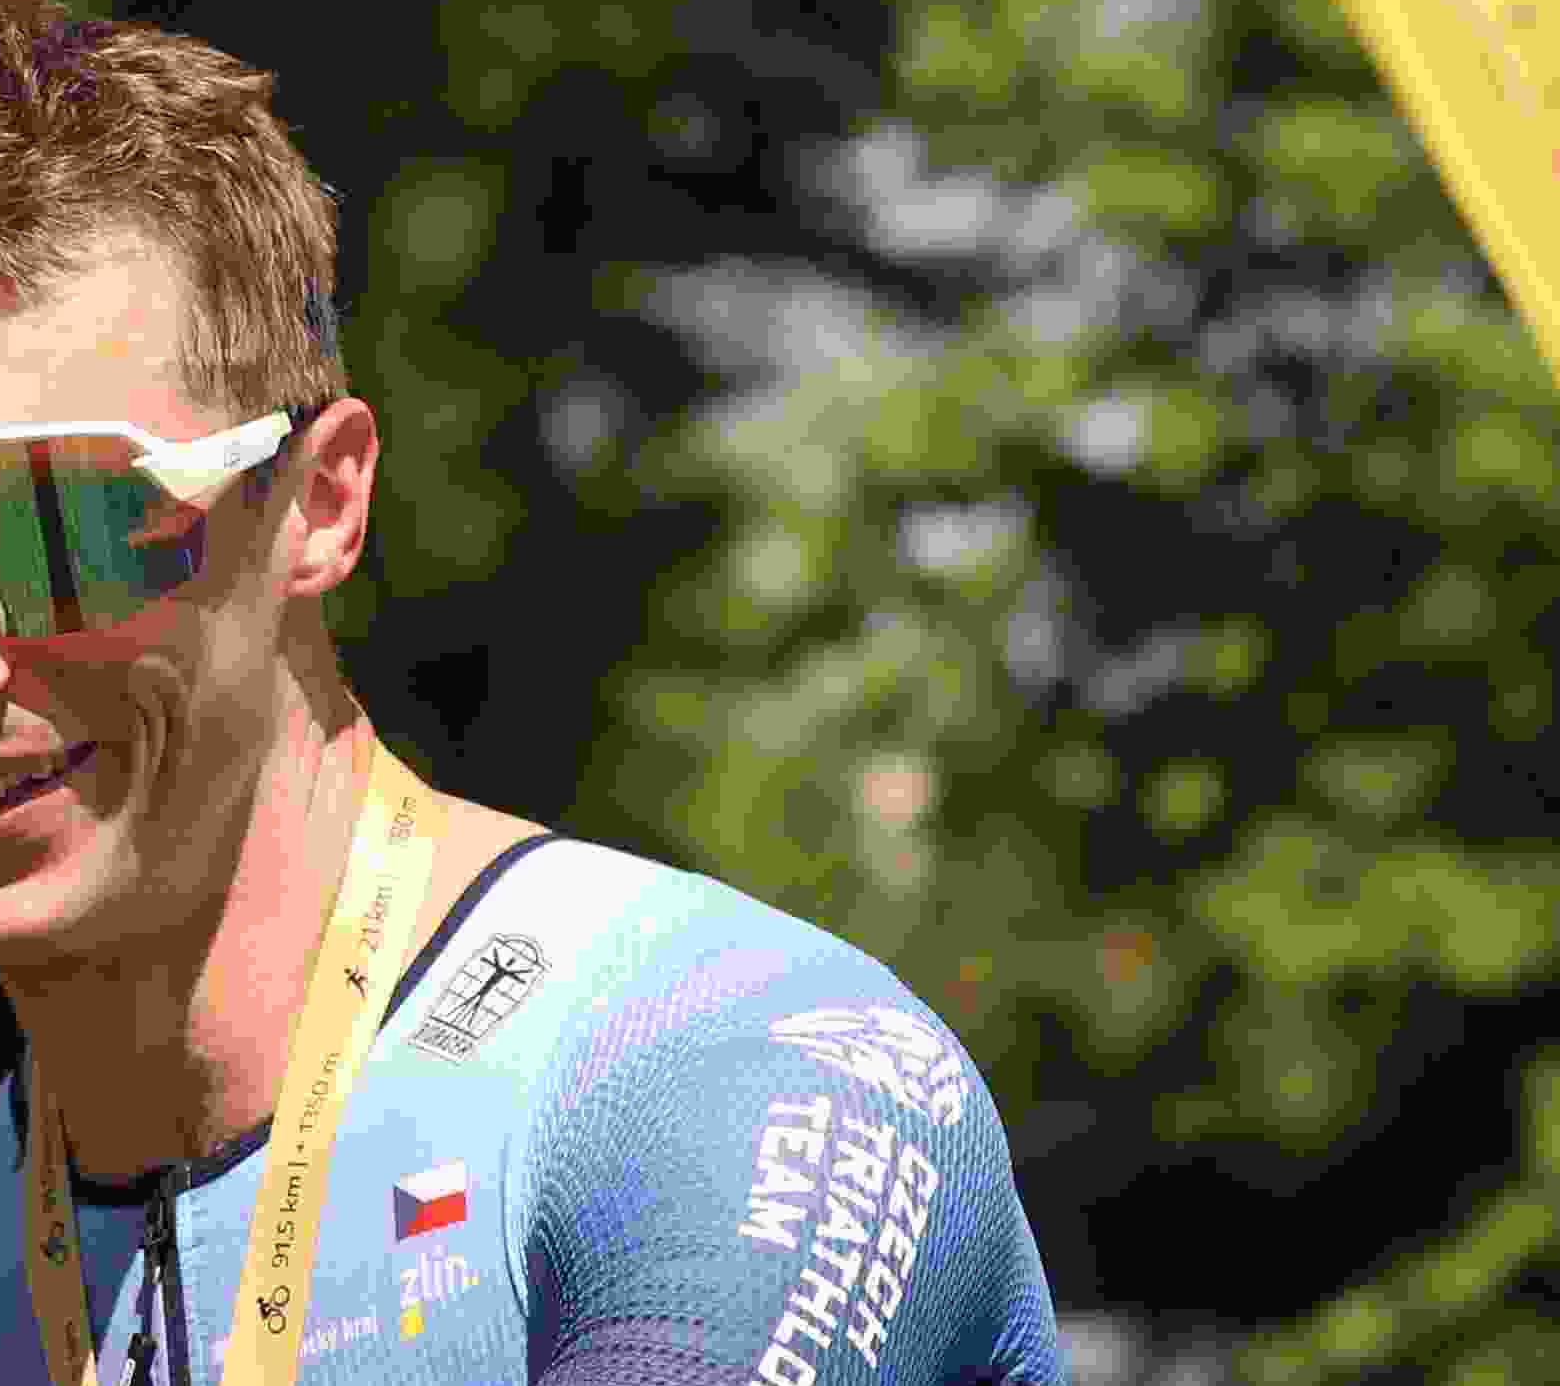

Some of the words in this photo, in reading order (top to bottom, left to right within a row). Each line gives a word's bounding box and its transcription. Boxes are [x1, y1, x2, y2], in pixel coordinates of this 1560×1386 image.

[299, 1078, 330, 1133] 1350
[279, 1175, 302, 1213] km
[736, 1093, 832, 1252] TEAM
[271, 1221, 296, 1268] 91,5
[847, 1142, 939, 1368] CZECH
